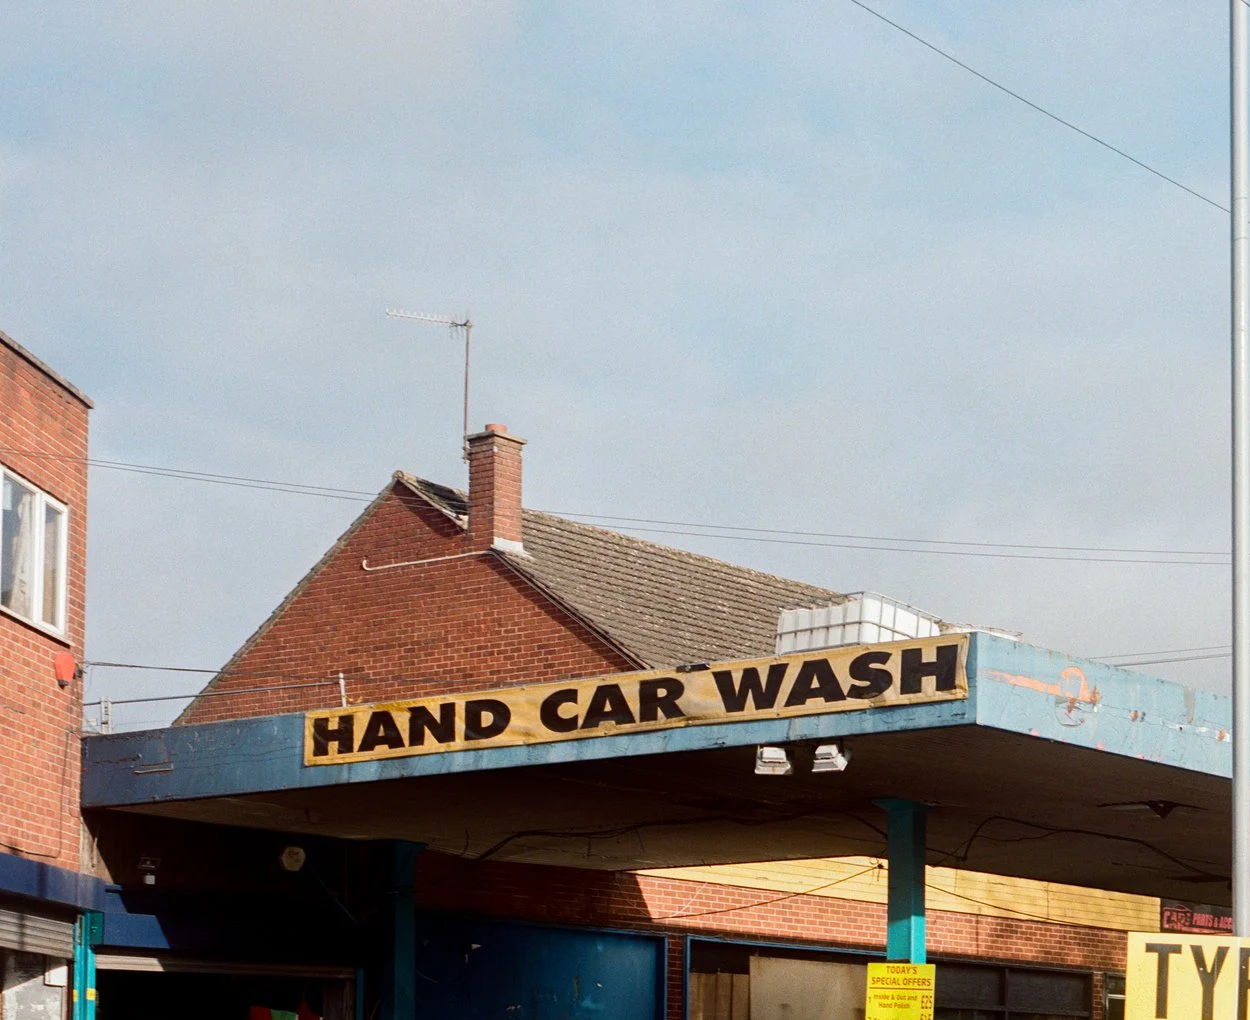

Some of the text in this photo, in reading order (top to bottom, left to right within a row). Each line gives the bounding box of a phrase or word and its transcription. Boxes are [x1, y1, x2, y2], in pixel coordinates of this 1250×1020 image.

[313, 644, 959, 756] HAND CAR WASH
[1193, 912, 1213, 927] PARTS
[886, 965, 918, 974] TODAY'S
[872, 977, 932, 986] SPECIAL OFFERS
